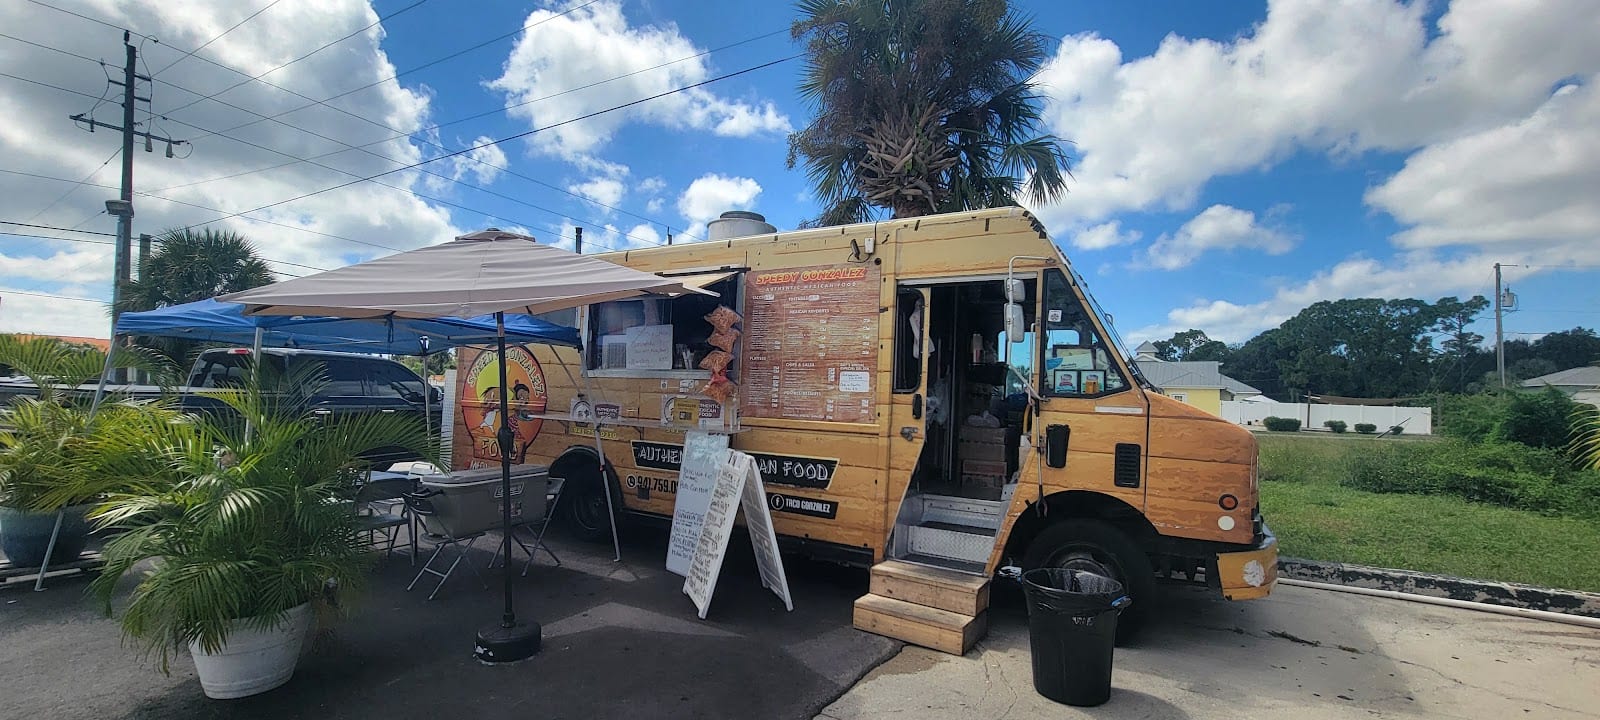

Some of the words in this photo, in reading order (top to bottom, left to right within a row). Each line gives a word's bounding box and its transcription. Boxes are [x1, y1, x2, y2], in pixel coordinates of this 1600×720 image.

[756, 272, 800, 285] SPEEDY
[801, 267, 867, 281] GONZALEZ
[505, 347, 545, 397] ONZALEZ
[783, 461, 828, 480] FOOD
[786, 498, 800, 508] TACO
[801, 500, 830, 513] GONZALEZ
